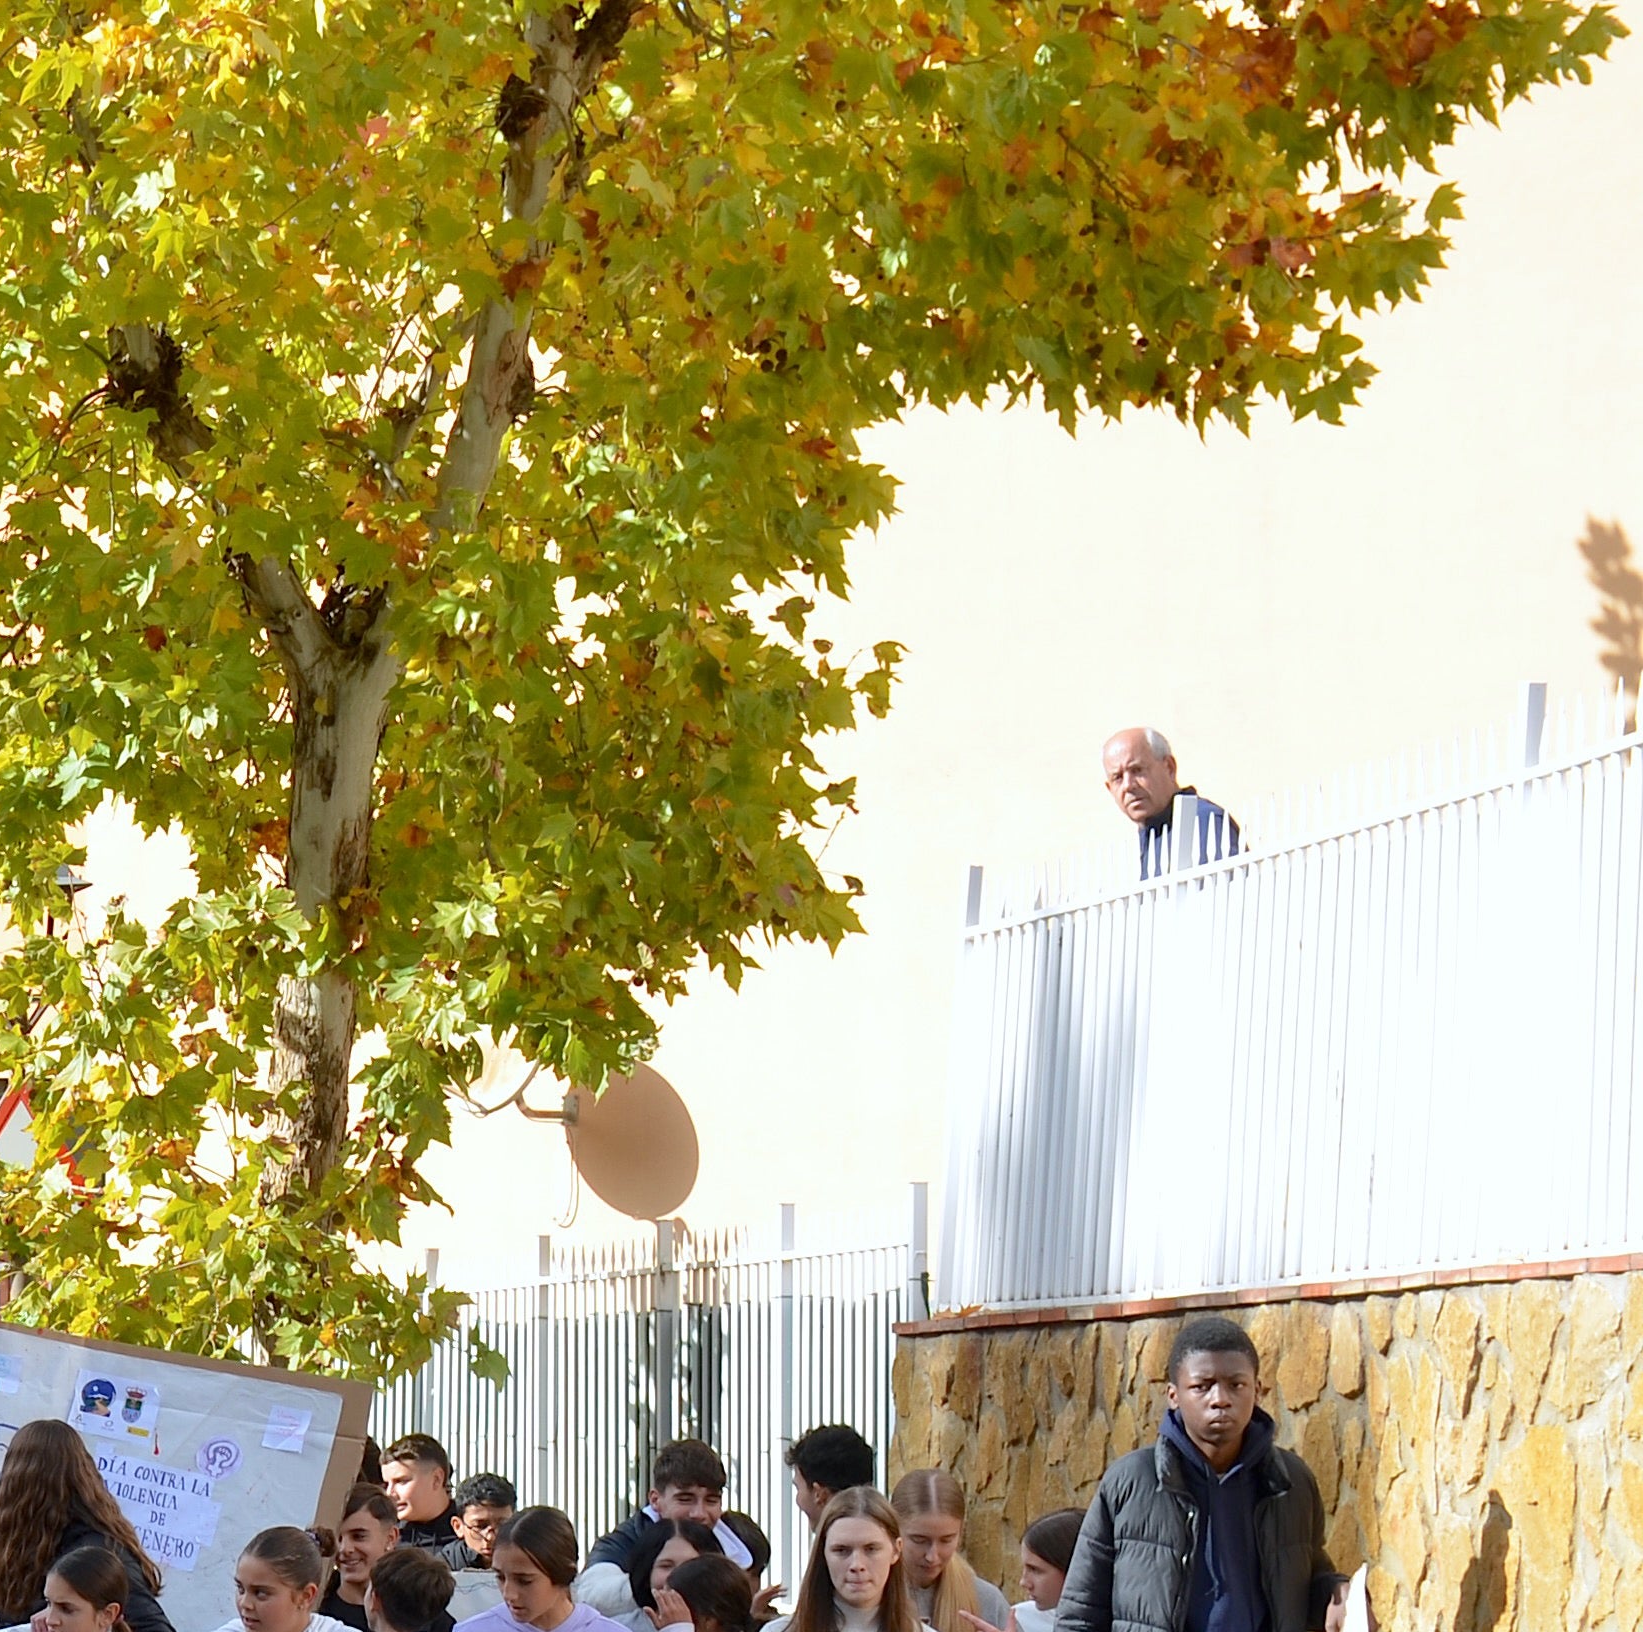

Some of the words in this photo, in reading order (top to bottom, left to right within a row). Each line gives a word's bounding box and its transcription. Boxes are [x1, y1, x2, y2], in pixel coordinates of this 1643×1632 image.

[97, 1456, 127, 1476] DÍA
[133, 1465, 186, 1492] CONTRA
[191, 1479, 211, 1498] LA
[103, 1479, 178, 1510] VIOLENCIA
[150, 1510, 167, 1526] DE
